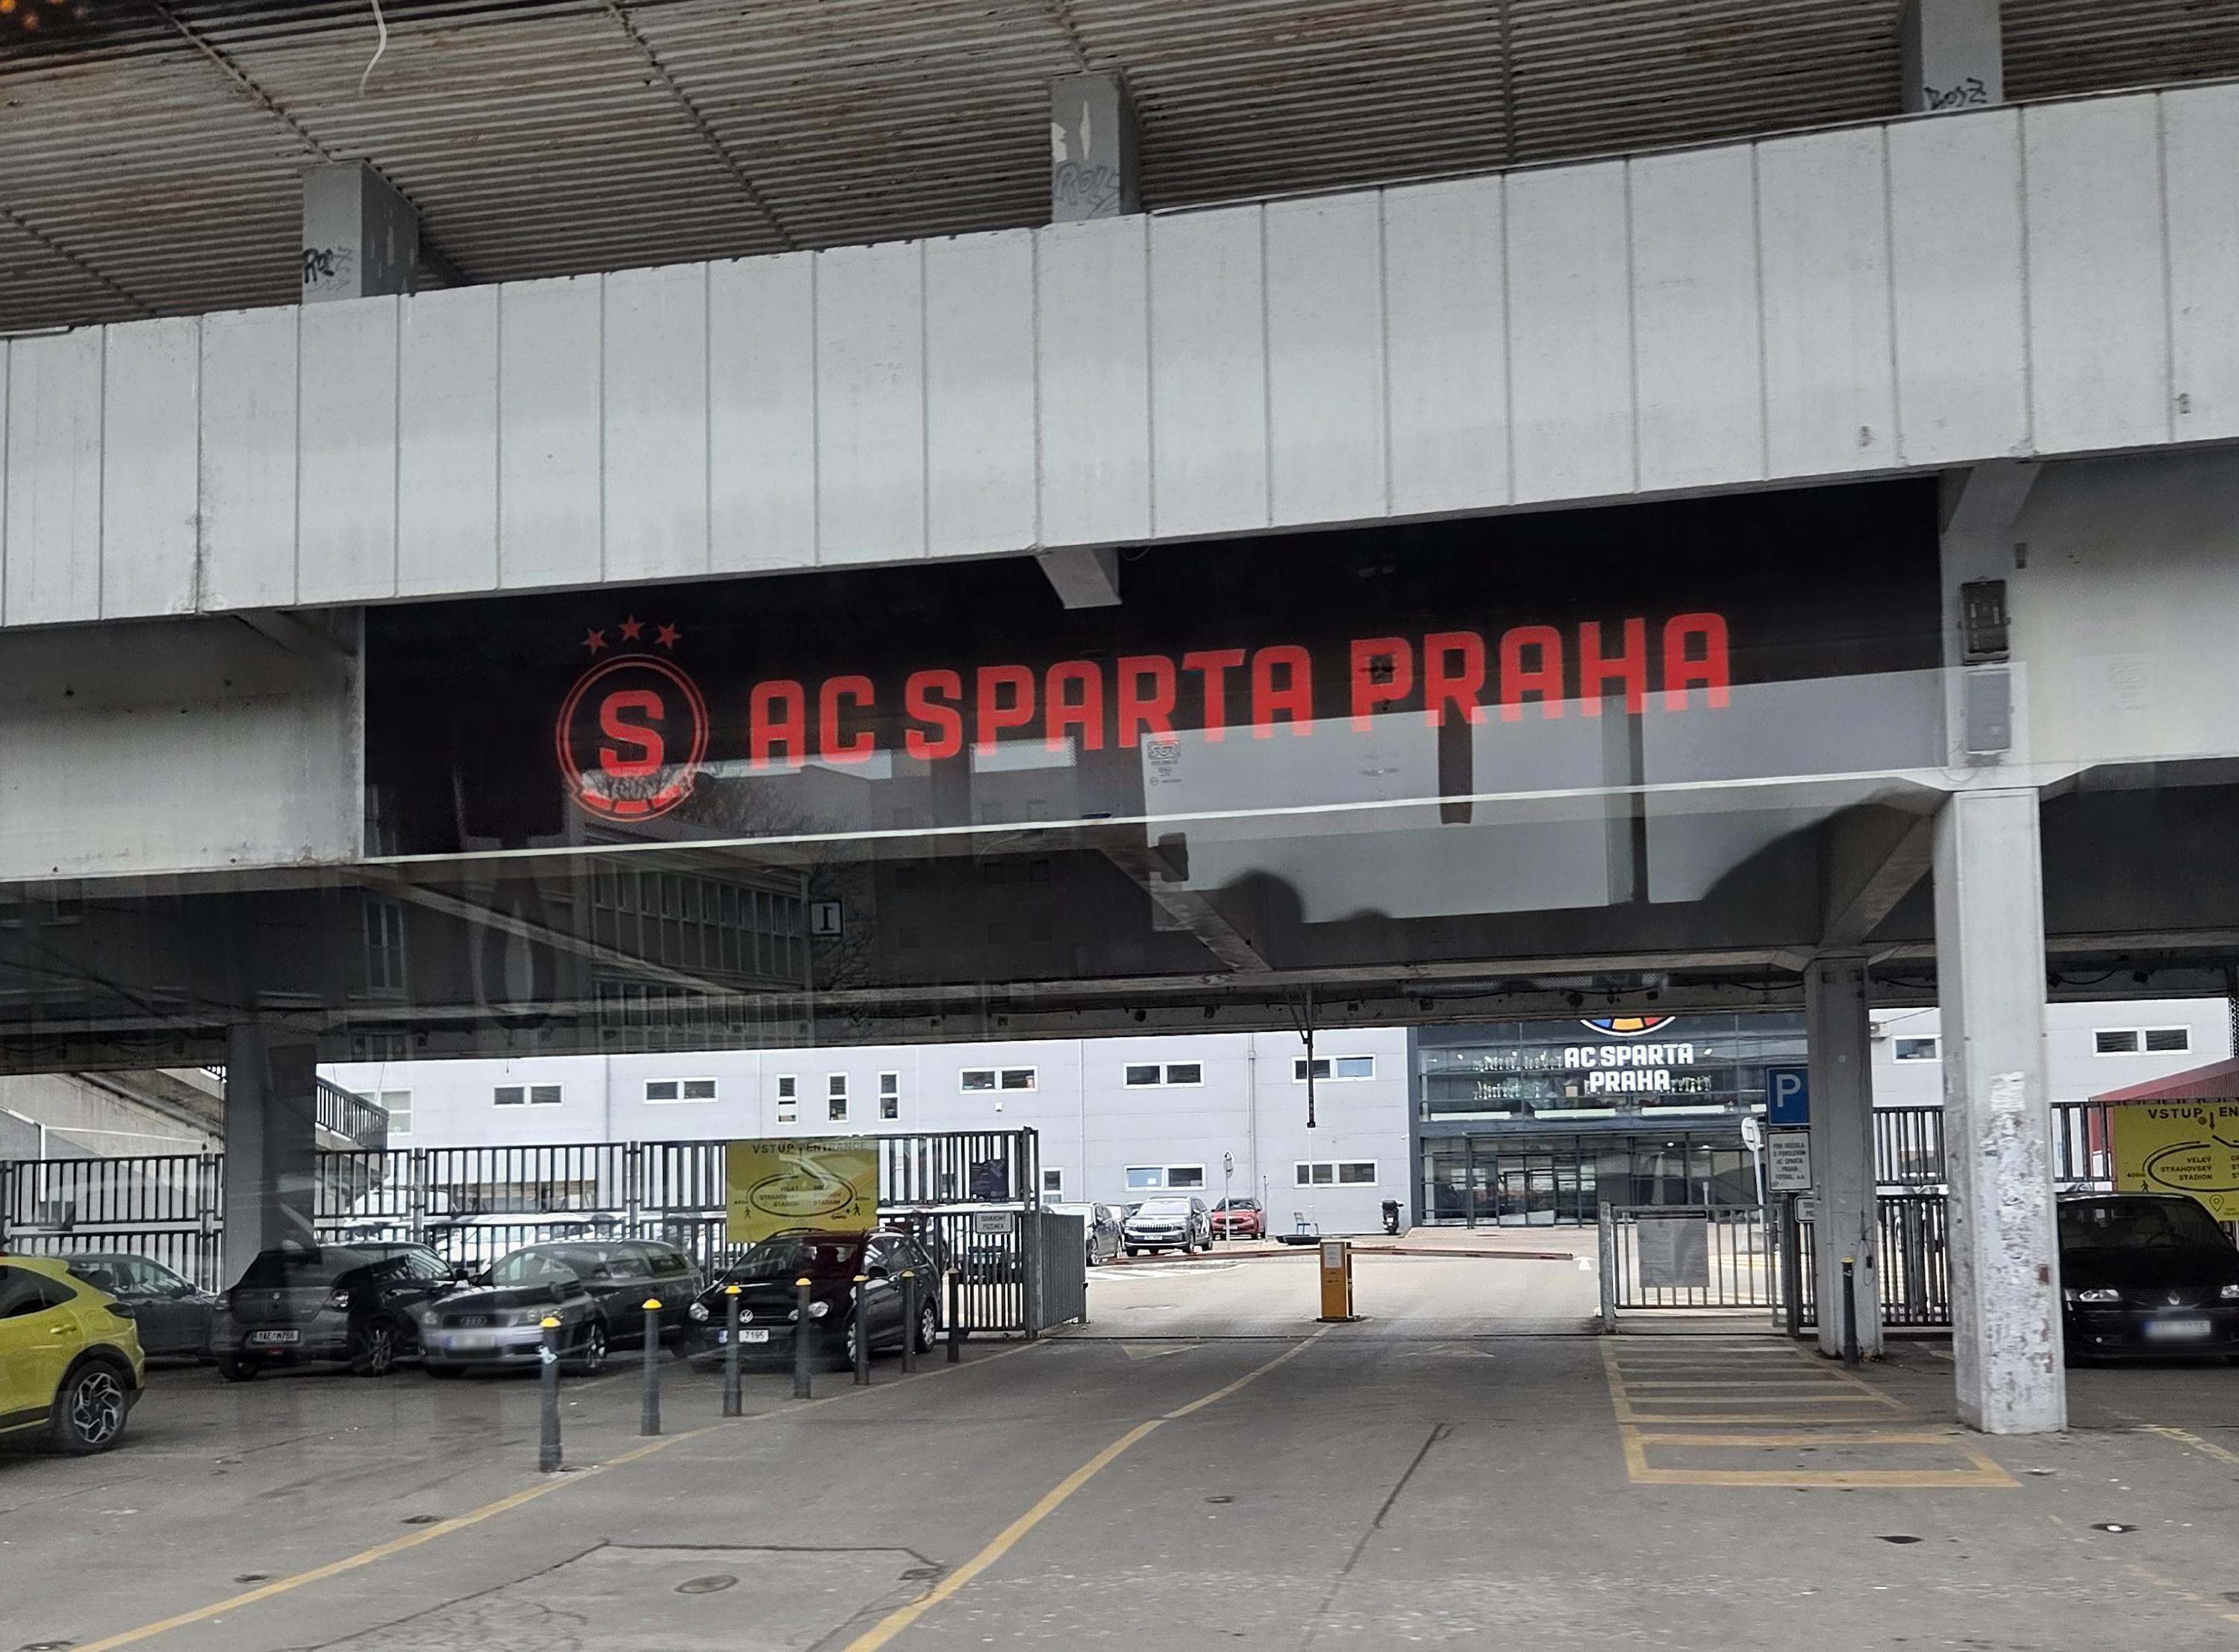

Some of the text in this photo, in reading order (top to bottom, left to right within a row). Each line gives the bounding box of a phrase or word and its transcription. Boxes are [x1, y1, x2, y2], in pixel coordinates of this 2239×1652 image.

[749, 611, 1731, 772] AC SPARTA PRAHA
[599, 689, 665, 778] S
[1564, 1042, 1694, 1069] AC SPARTA
[1589, 1069, 1670, 1093] PRAHA
[1776, 1073, 1801, 1108] P
[2148, 1108, 2203, 1119] VSTUP
[752, 1143, 795, 1154] VSTUP
